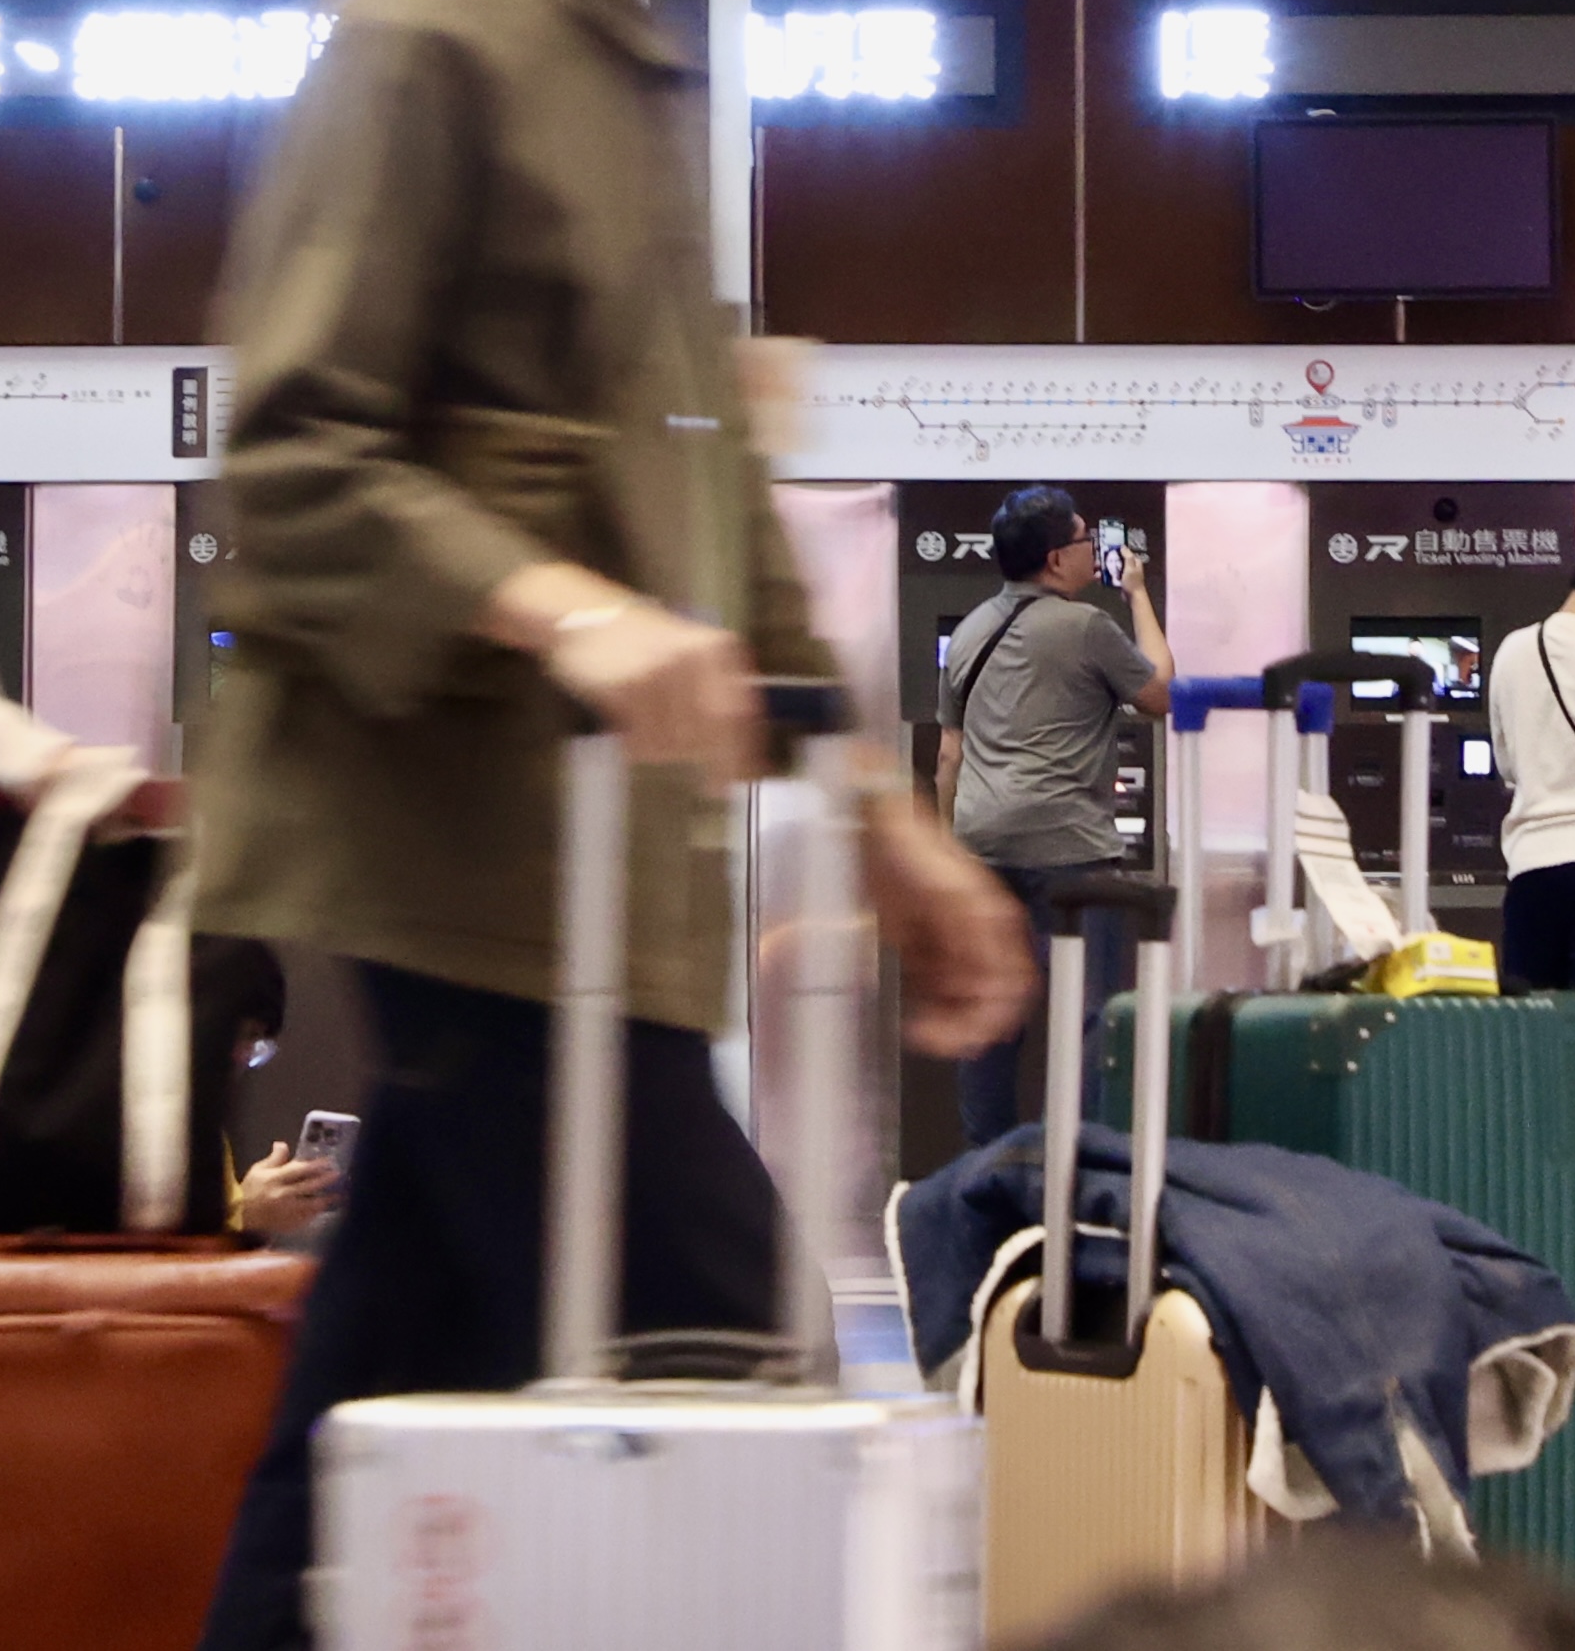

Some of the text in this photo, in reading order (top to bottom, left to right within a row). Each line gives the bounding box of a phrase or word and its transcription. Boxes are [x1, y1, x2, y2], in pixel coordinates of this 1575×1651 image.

[1414, 528, 1560, 553] 自動售票機
